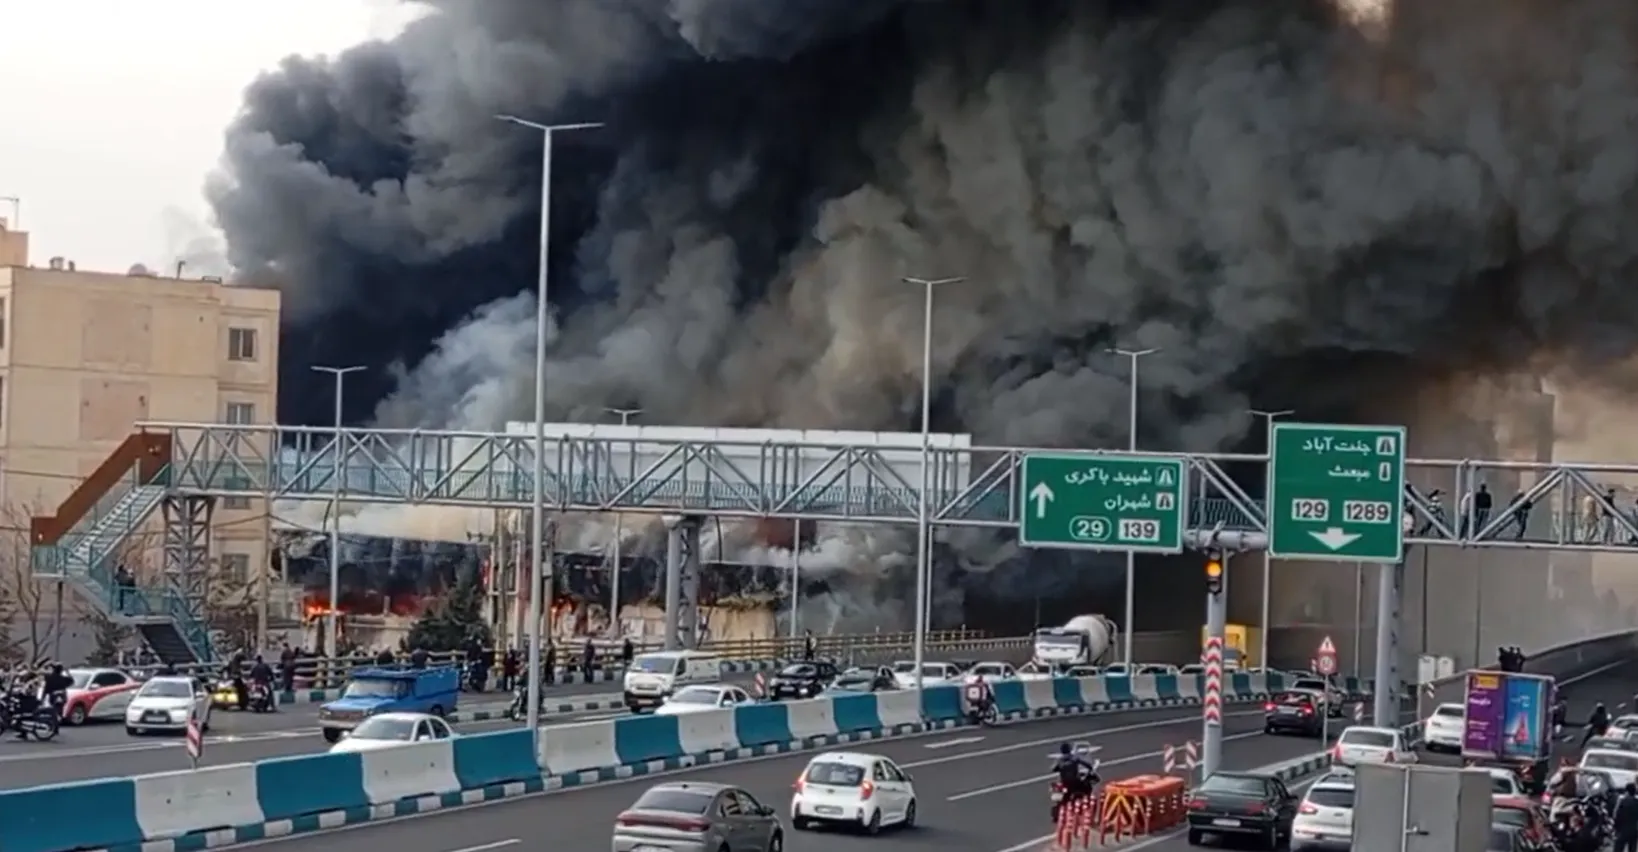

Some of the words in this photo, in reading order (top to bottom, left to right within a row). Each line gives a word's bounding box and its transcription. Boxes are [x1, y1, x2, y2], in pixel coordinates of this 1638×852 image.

[1302, 436, 1334, 455] آباد
[1334, 440, 1372, 456] جنت
[1064, 467, 1109, 486] باکری
[1113, 467, 1153, 486] شهید
[1328, 465, 1371, 482] مبعث
[1104, 493, 1152, 511] شهران
[1294, 501, 1326, 519] 129
[1345, 503, 1389, 521] 1289
[1077, 520, 1104, 537] 29
[1123, 522, 1156, 539] 139
